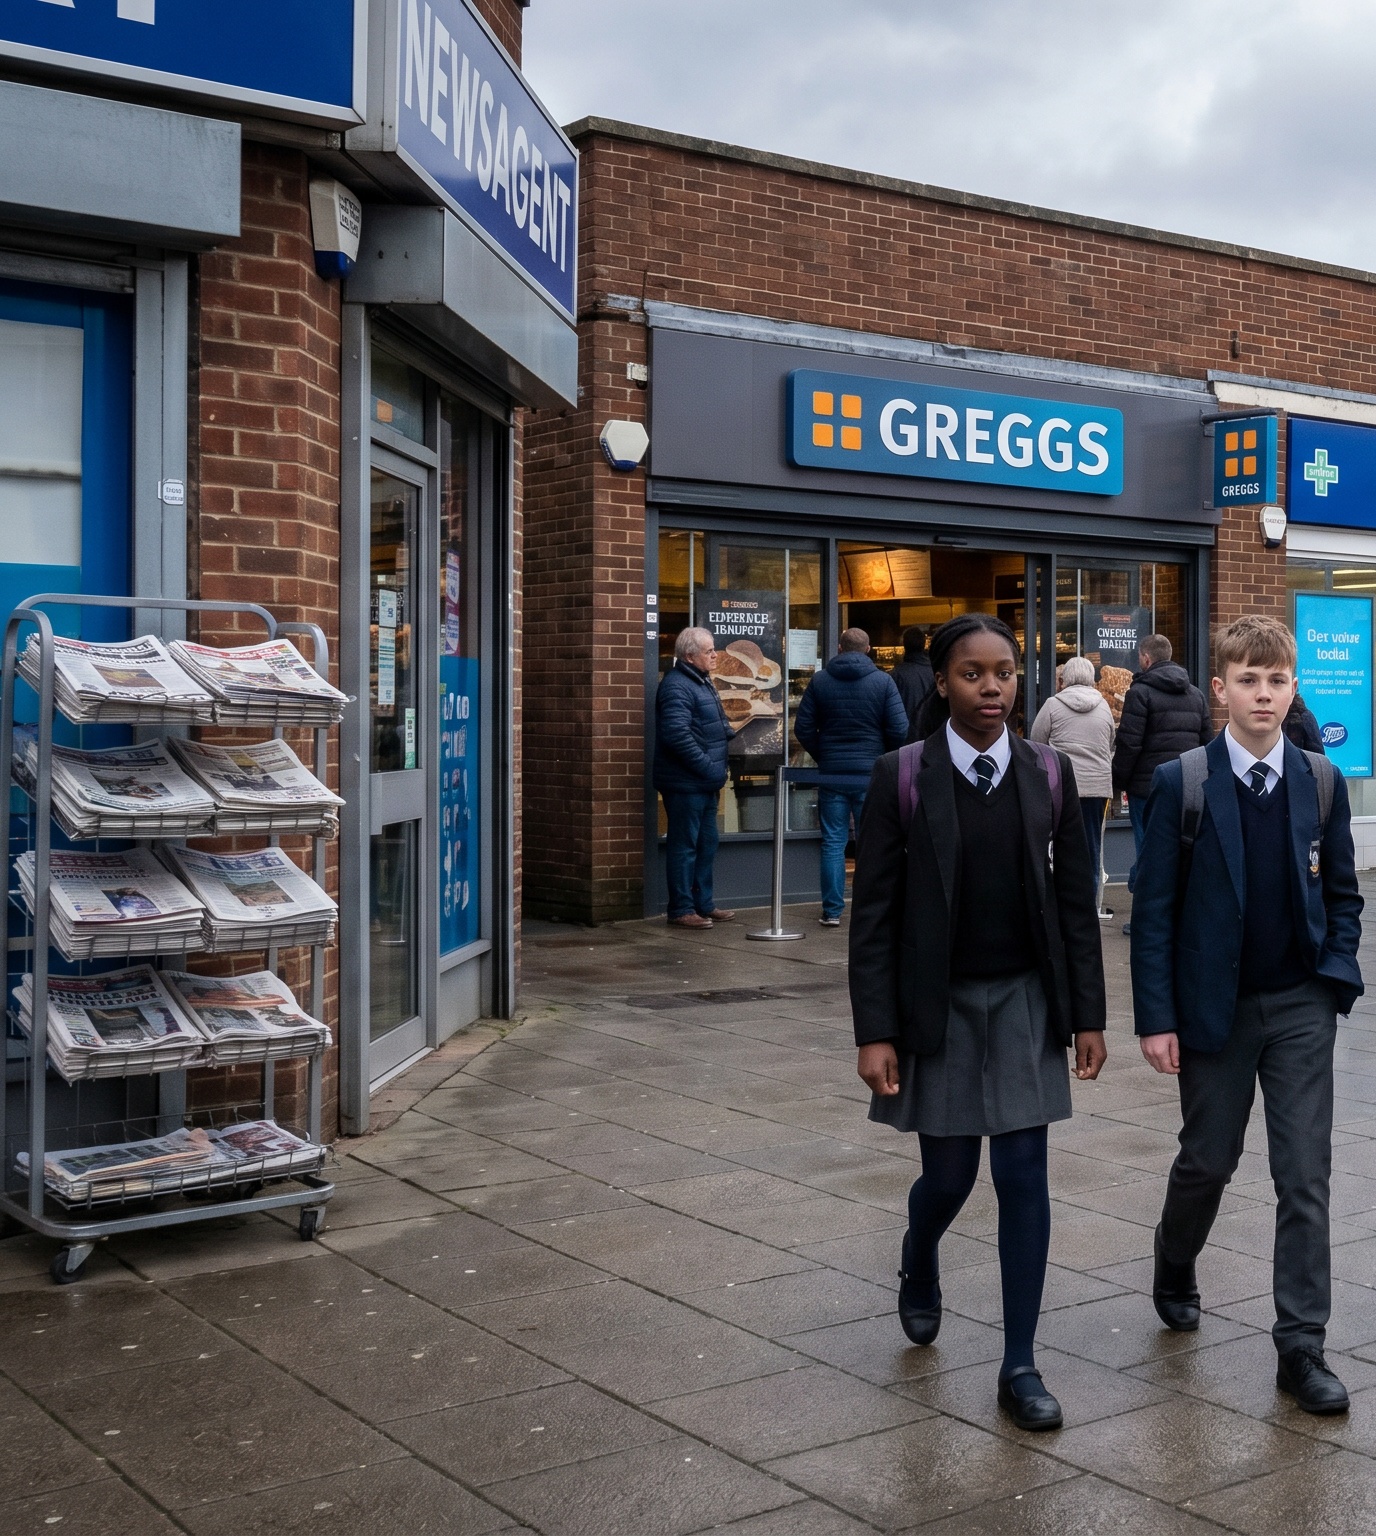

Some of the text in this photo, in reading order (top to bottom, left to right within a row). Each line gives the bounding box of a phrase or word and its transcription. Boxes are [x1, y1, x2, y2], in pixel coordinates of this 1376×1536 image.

[405, 0, 571, 273] NEWSAGENT
[879, 398, 1109, 476] GREGGS
[1222, 482, 1260, 497] GREGGS
